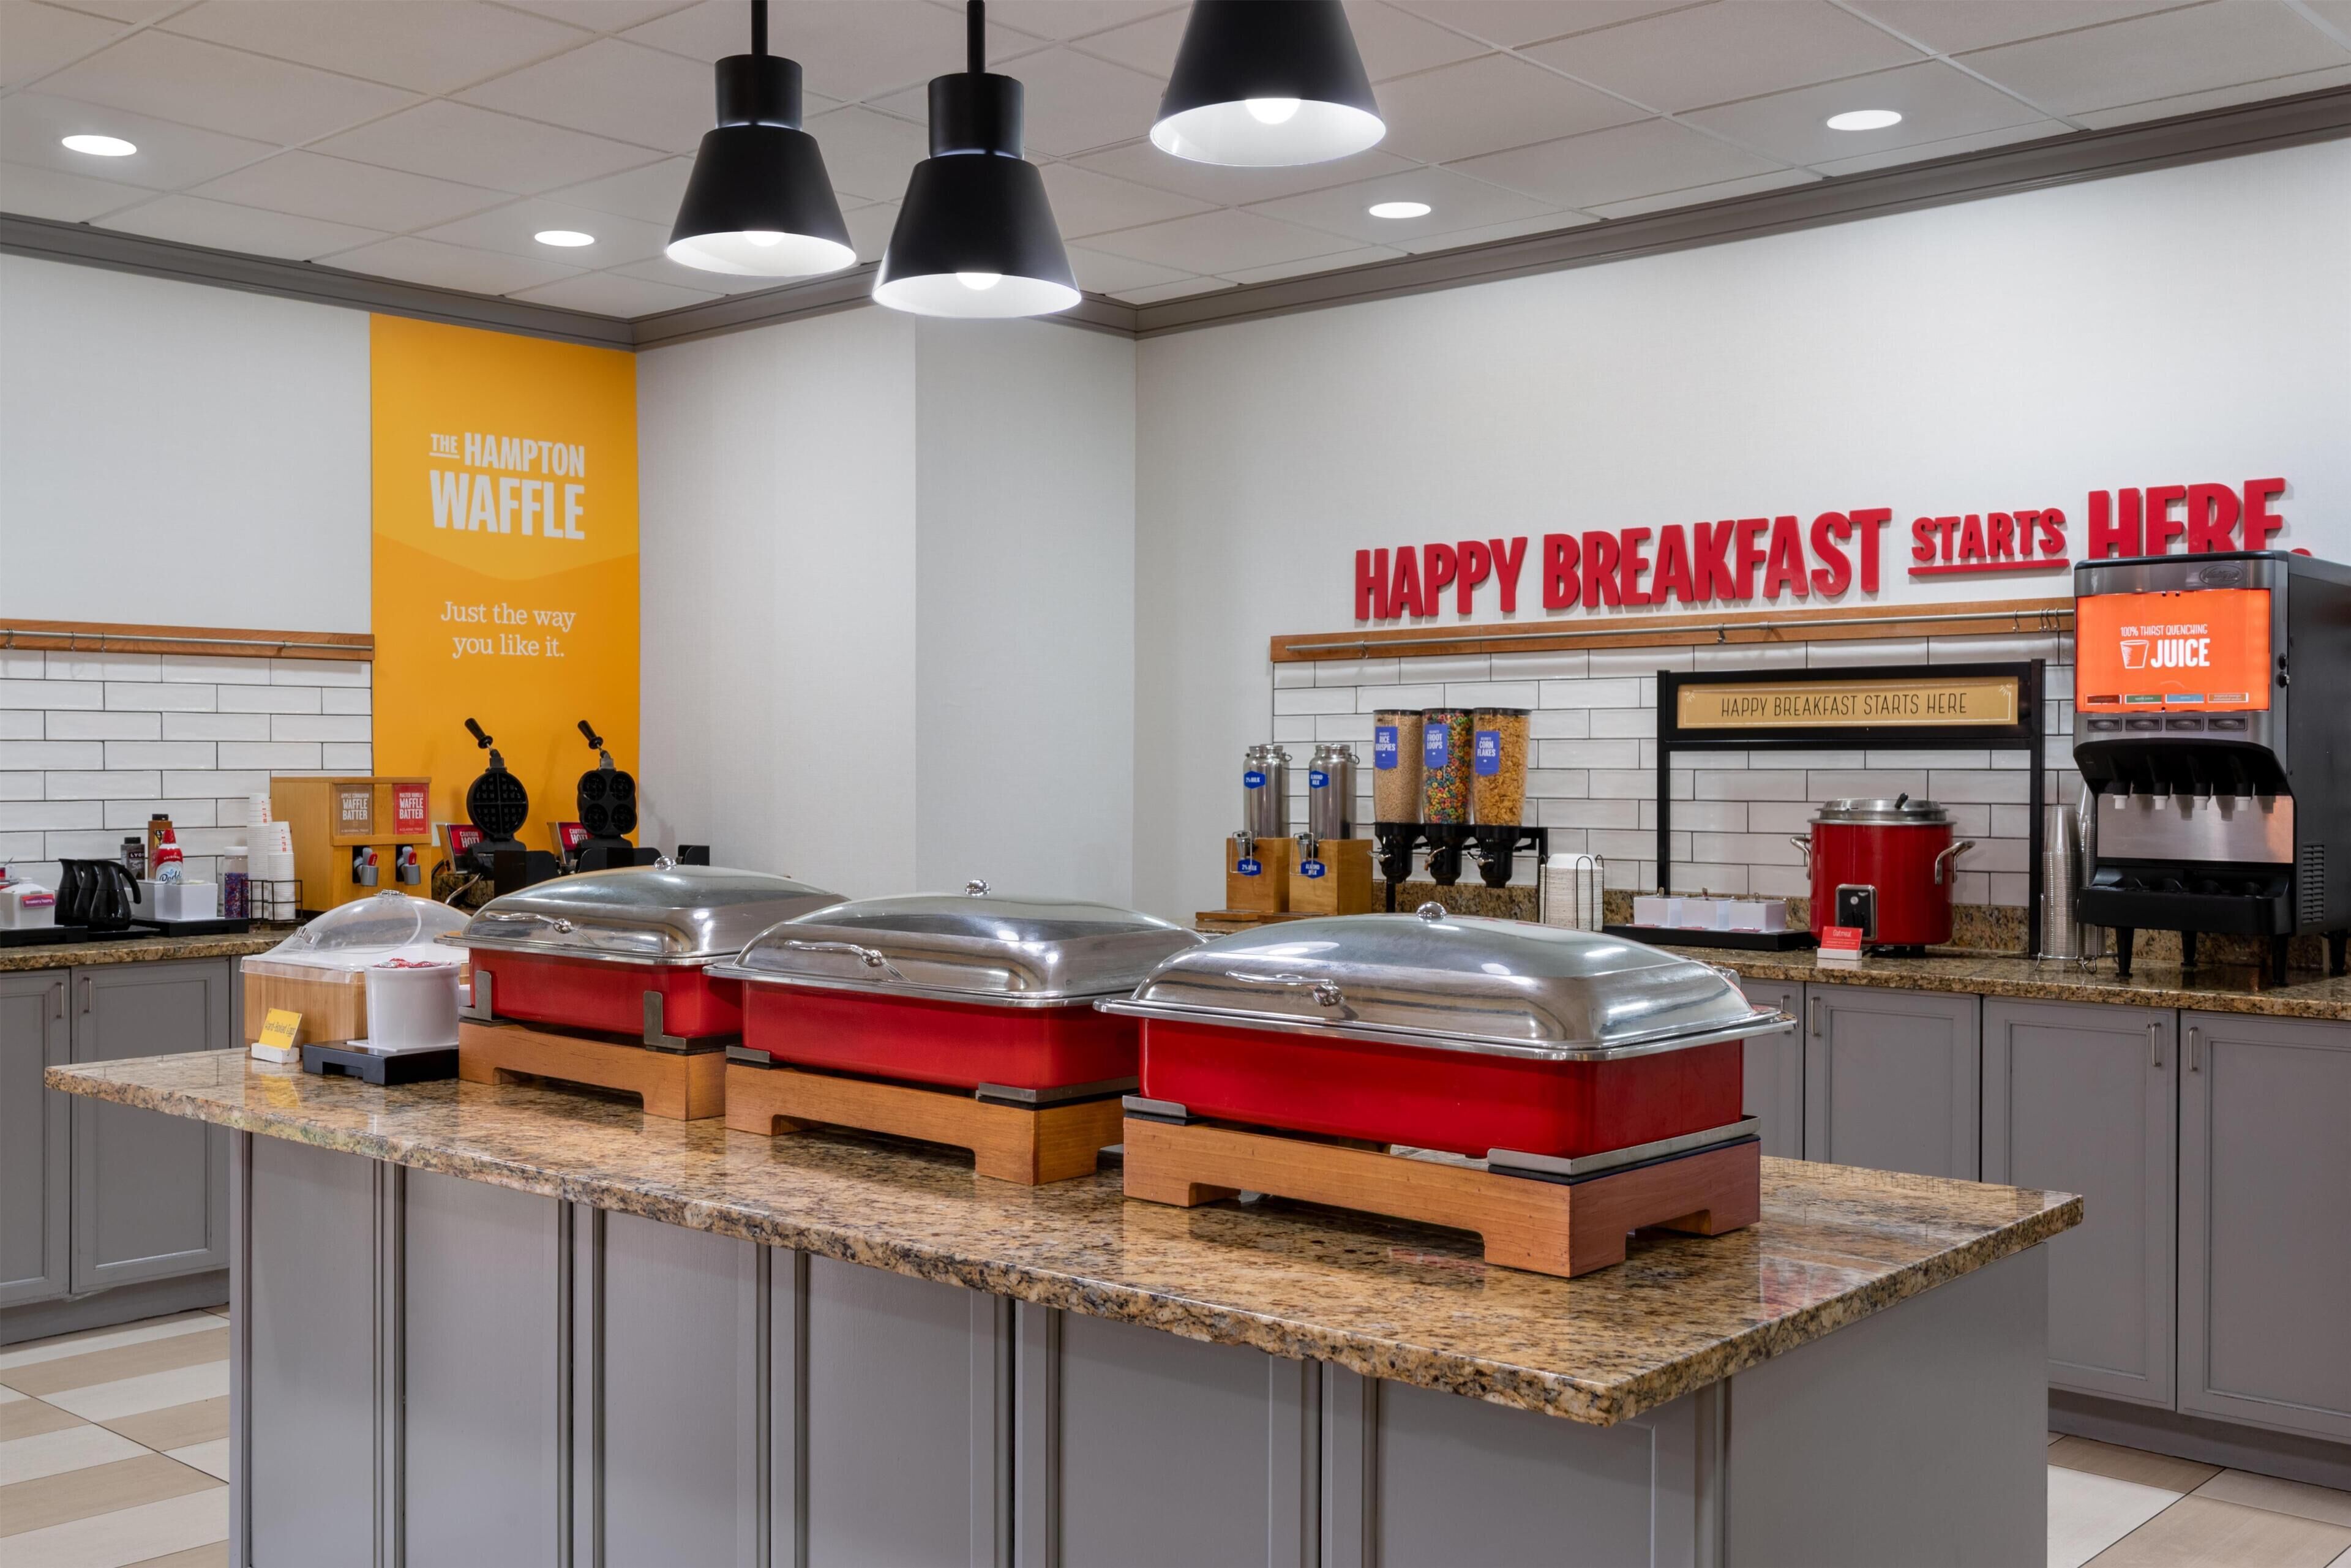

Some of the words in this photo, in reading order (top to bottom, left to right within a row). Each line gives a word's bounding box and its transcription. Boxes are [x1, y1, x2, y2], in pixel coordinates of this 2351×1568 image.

[430, 433, 458, 453] THE
[465, 432, 585, 478] HAMPTON
[430, 470, 585, 539] WAFFLE
[1355, 536, 1528, 620] HAPPY
[1543, 508, 1892, 608] BREAKFAST
[1911, 508, 2066, 561] STARTS
[441, 601, 487, 623] Just
[492, 602, 528, 625] the
[533, 610, 576, 632] way
[2120, 626, 2139, 637] 100%
[2140, 625, 2165, 636] THIRST
[2165, 624, 2208, 636] QUENCHING
[452, 637, 493, 659] you
[500, 634, 539, 656] like
[546, 636, 564, 657] it.
[2150, 638, 2211, 668] JUICE
[1722, 697, 1768, 717] HAPPY
[1774, 695, 1858, 716] BREAKFAST
[1864, 694, 1919, 715] STARTS
[1927, 692, 1967, 714] HERE
[1477, 748, 1496, 757] FLAKES
[343, 798, 367, 809] WAFFLE
[399, 798, 424, 808] WAFFLE
[343, 810, 367, 820] BATTER
[399, 809, 424, 819] BATTER
[1832, 929, 1852, 937] Oatmeal
